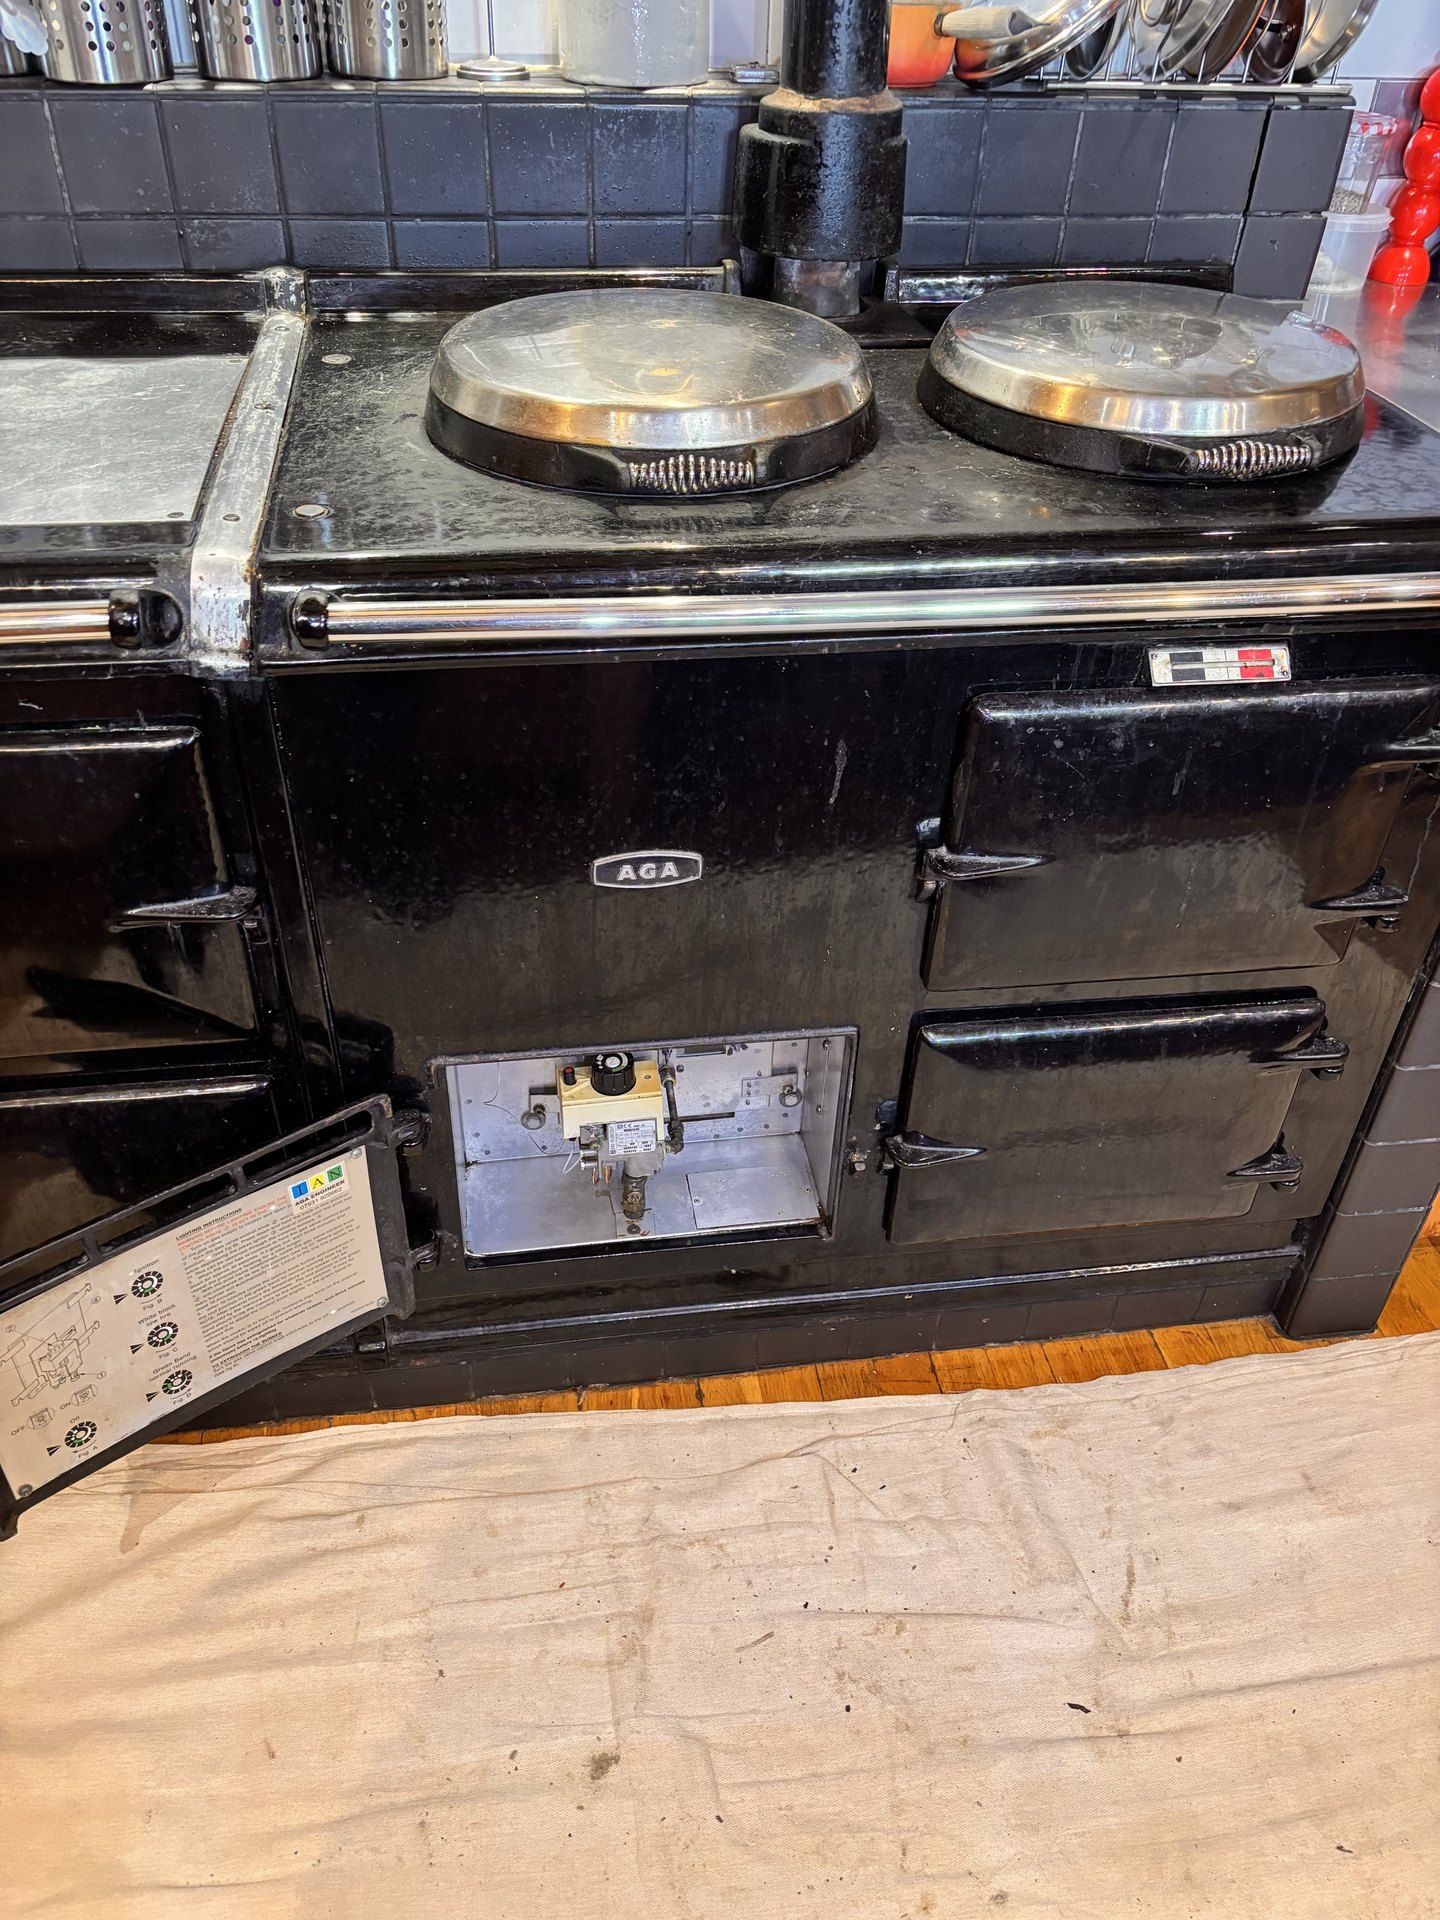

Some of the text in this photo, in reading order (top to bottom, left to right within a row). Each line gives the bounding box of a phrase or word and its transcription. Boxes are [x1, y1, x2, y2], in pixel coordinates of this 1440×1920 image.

[617, 862, 679, 881] AGA
[295, 1180, 345, 1206] AGA ENGINEER
[175, 1208, 242, 1240] LIGHTING INSTRUCTIONS
[135, 1259, 160, 1274] Ignition
[138, 1303, 176, 1325] White block
[143, 1303, 154, 1311] Fig
[146, 1312, 171, 1327] low fire
[152, 1352, 191, 1375] Green Band
[159, 1352, 170, 1360] Fig
[149, 1369, 172, 1383] normal
[173, 1355, 197, 1370] running
[60, 1401, 72, 1410] ON
[172, 1397, 184, 1405] Fig
[11, 1425, 26, 1436] OFF
[78, 1451, 90, 1459] Fig
